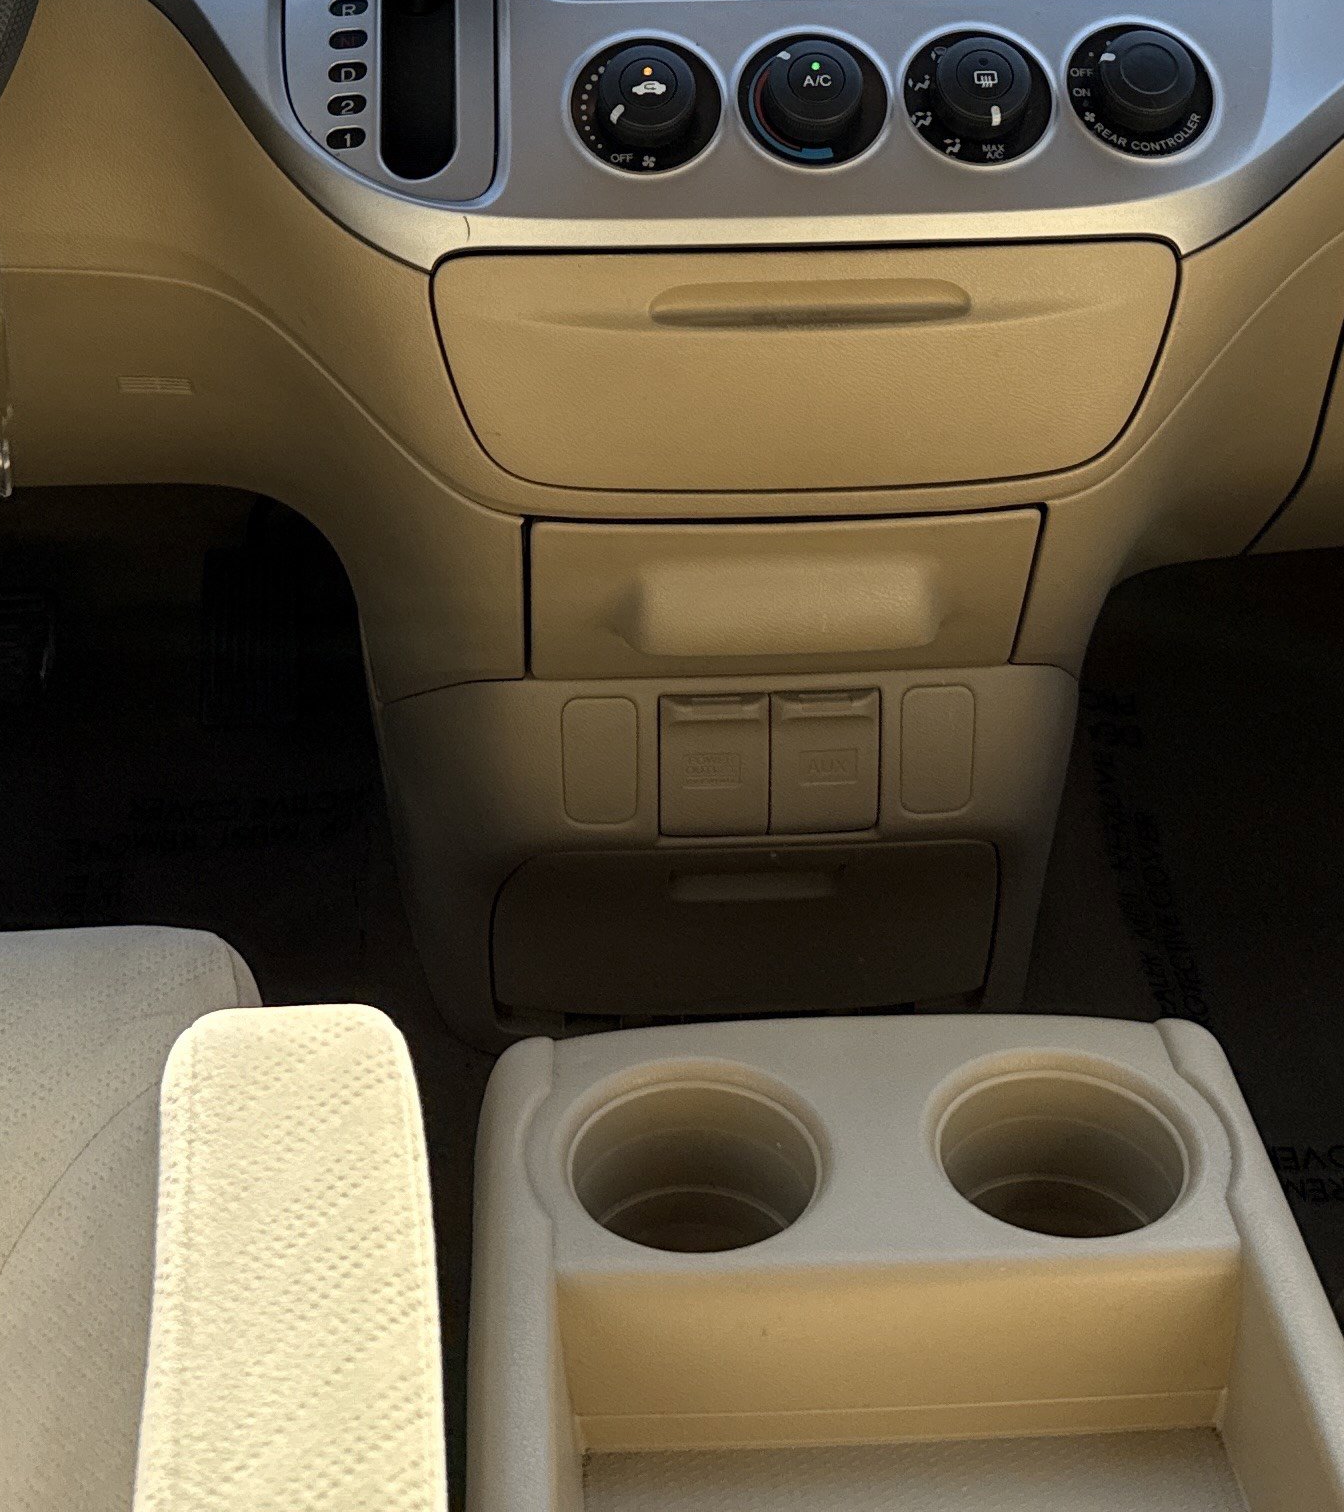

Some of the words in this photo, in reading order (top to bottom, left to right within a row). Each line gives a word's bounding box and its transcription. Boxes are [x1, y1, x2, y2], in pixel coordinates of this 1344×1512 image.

[341, 3, 356, 17] R
[340, 67, 356, 82] D
[1069, 68, 1093, 77] OFF
[802, 74, 832, 88] A/C
[1072, 88, 1091, 98] ON
[340, 100, 355, 115] 2
[1093, 122, 1128, 147] REAR
[1130, 112, 1202, 151] CONTROLLER
[343, 132, 352, 148] 1
[982, 144, 1005, 153] MAX
[610, 153, 634, 163] OFF
[808, 758, 848, 774] AUX
